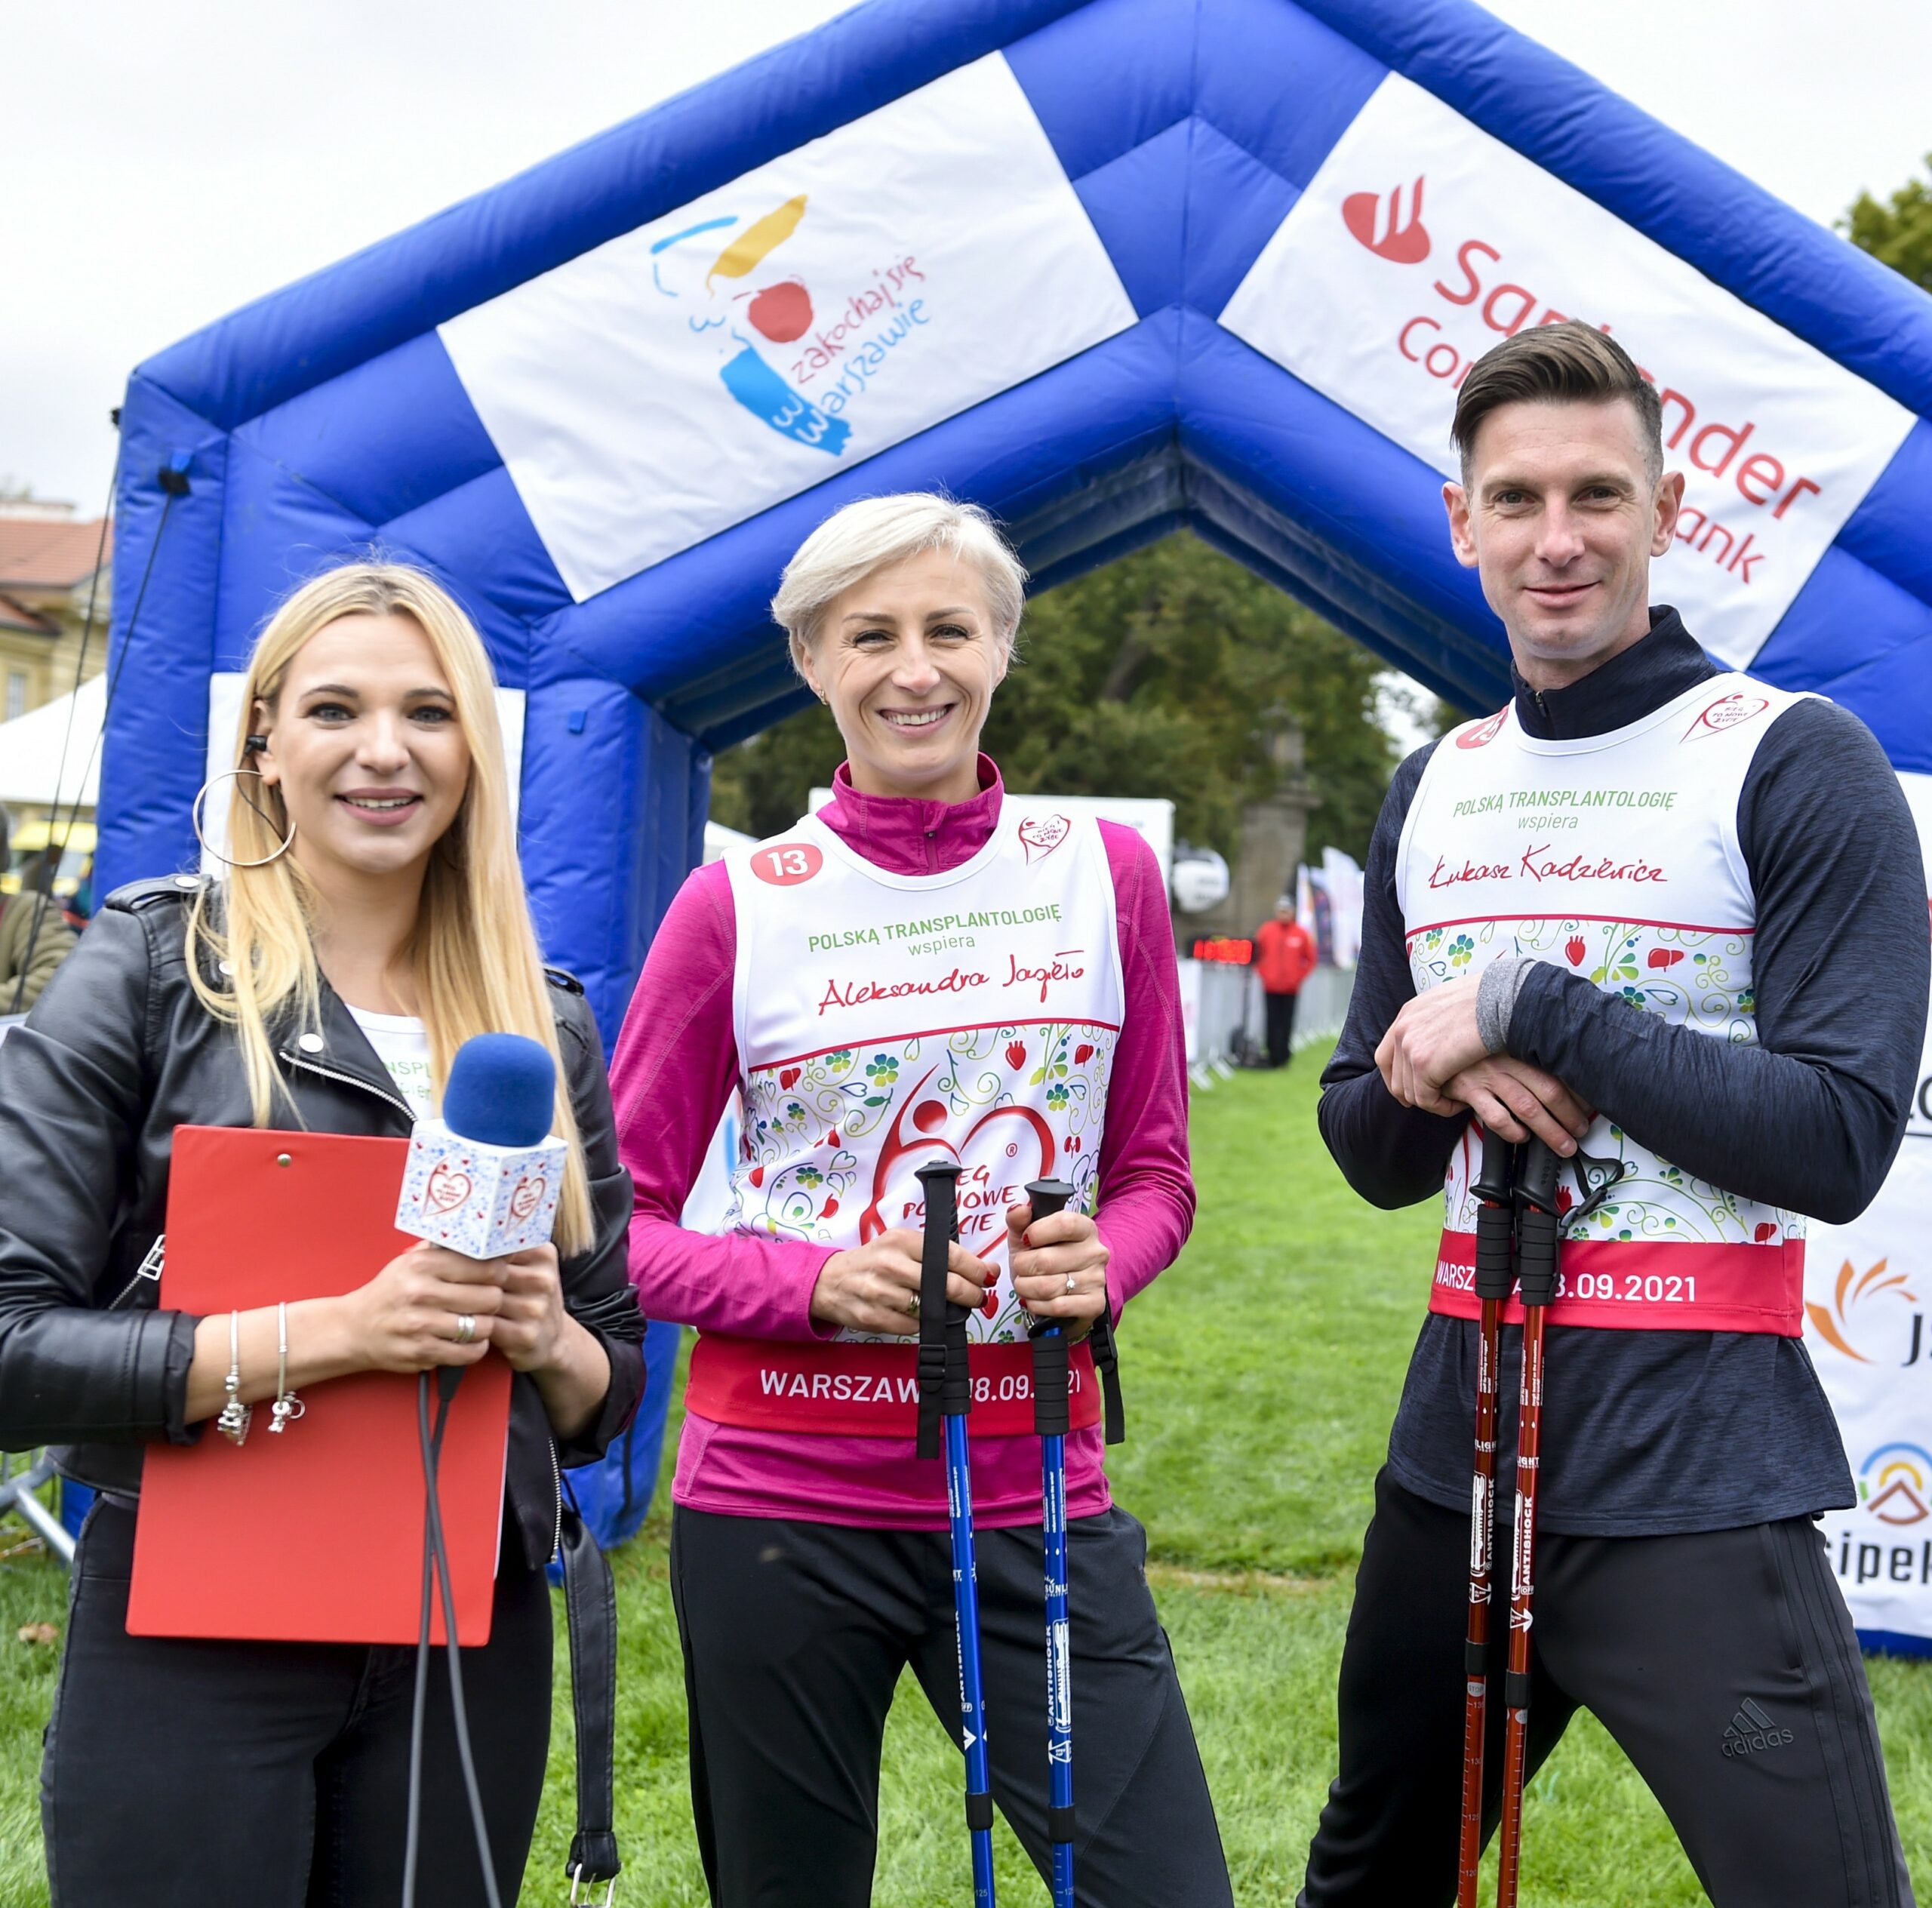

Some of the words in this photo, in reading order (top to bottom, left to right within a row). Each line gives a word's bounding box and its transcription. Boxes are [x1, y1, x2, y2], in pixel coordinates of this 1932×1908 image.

[792, 268, 897, 384] zakochaj
[1433, 239, 1822, 520] Sander
[1675, 506, 1765, 584] ank
[1453, 793, 1503, 818] POLSKĄ
[1508, 789, 1678, 811] TRANSPLANTOLOGIĘ
[1517, 814, 1579, 832] wspiera
[766, 849, 808, 877] 13
[1428, 854, 1512, 889] Łukasz
[808, 925, 880, 953] POLSKĄ
[883, 903, 1062, 940] TRANSPLANTOLOGIĘ
[907, 934, 976, 957] wspiera
[818, 968, 990, 1016] Aleksandra
[955, 1165, 990, 1188] EG
[760, 1368, 921, 1404] WARSZAW
[968, 1368, 1081, 1402] 18.09.21
[1522, 1496, 1533, 1585] ANTISHOCK
[1046, 1625, 1054, 1717] ANTISHOCK
[1721, 1728, 1794, 1757] adidas
